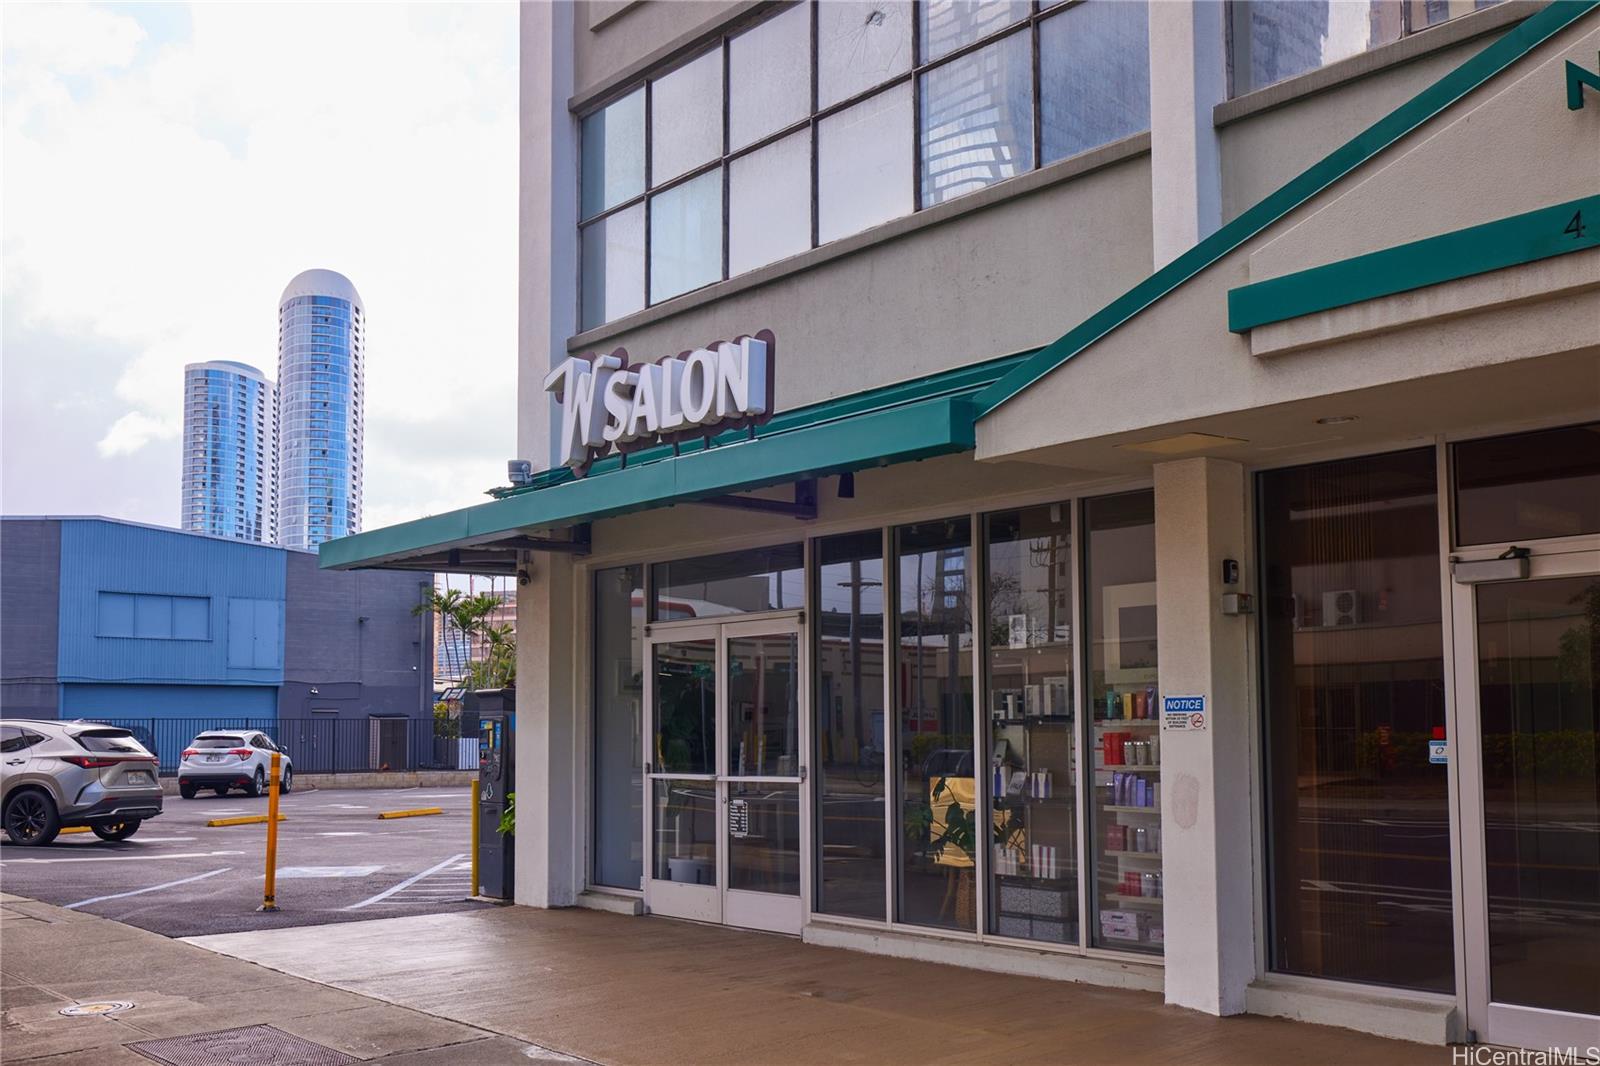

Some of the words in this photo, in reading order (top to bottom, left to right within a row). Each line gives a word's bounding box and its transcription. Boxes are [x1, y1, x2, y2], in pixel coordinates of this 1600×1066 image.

[1563, 209, 1586, 239] 4
[544, 355, 621, 468] W
[602, 337, 767, 442] SALON
[1166, 699, 1202, 710] NOTICE
